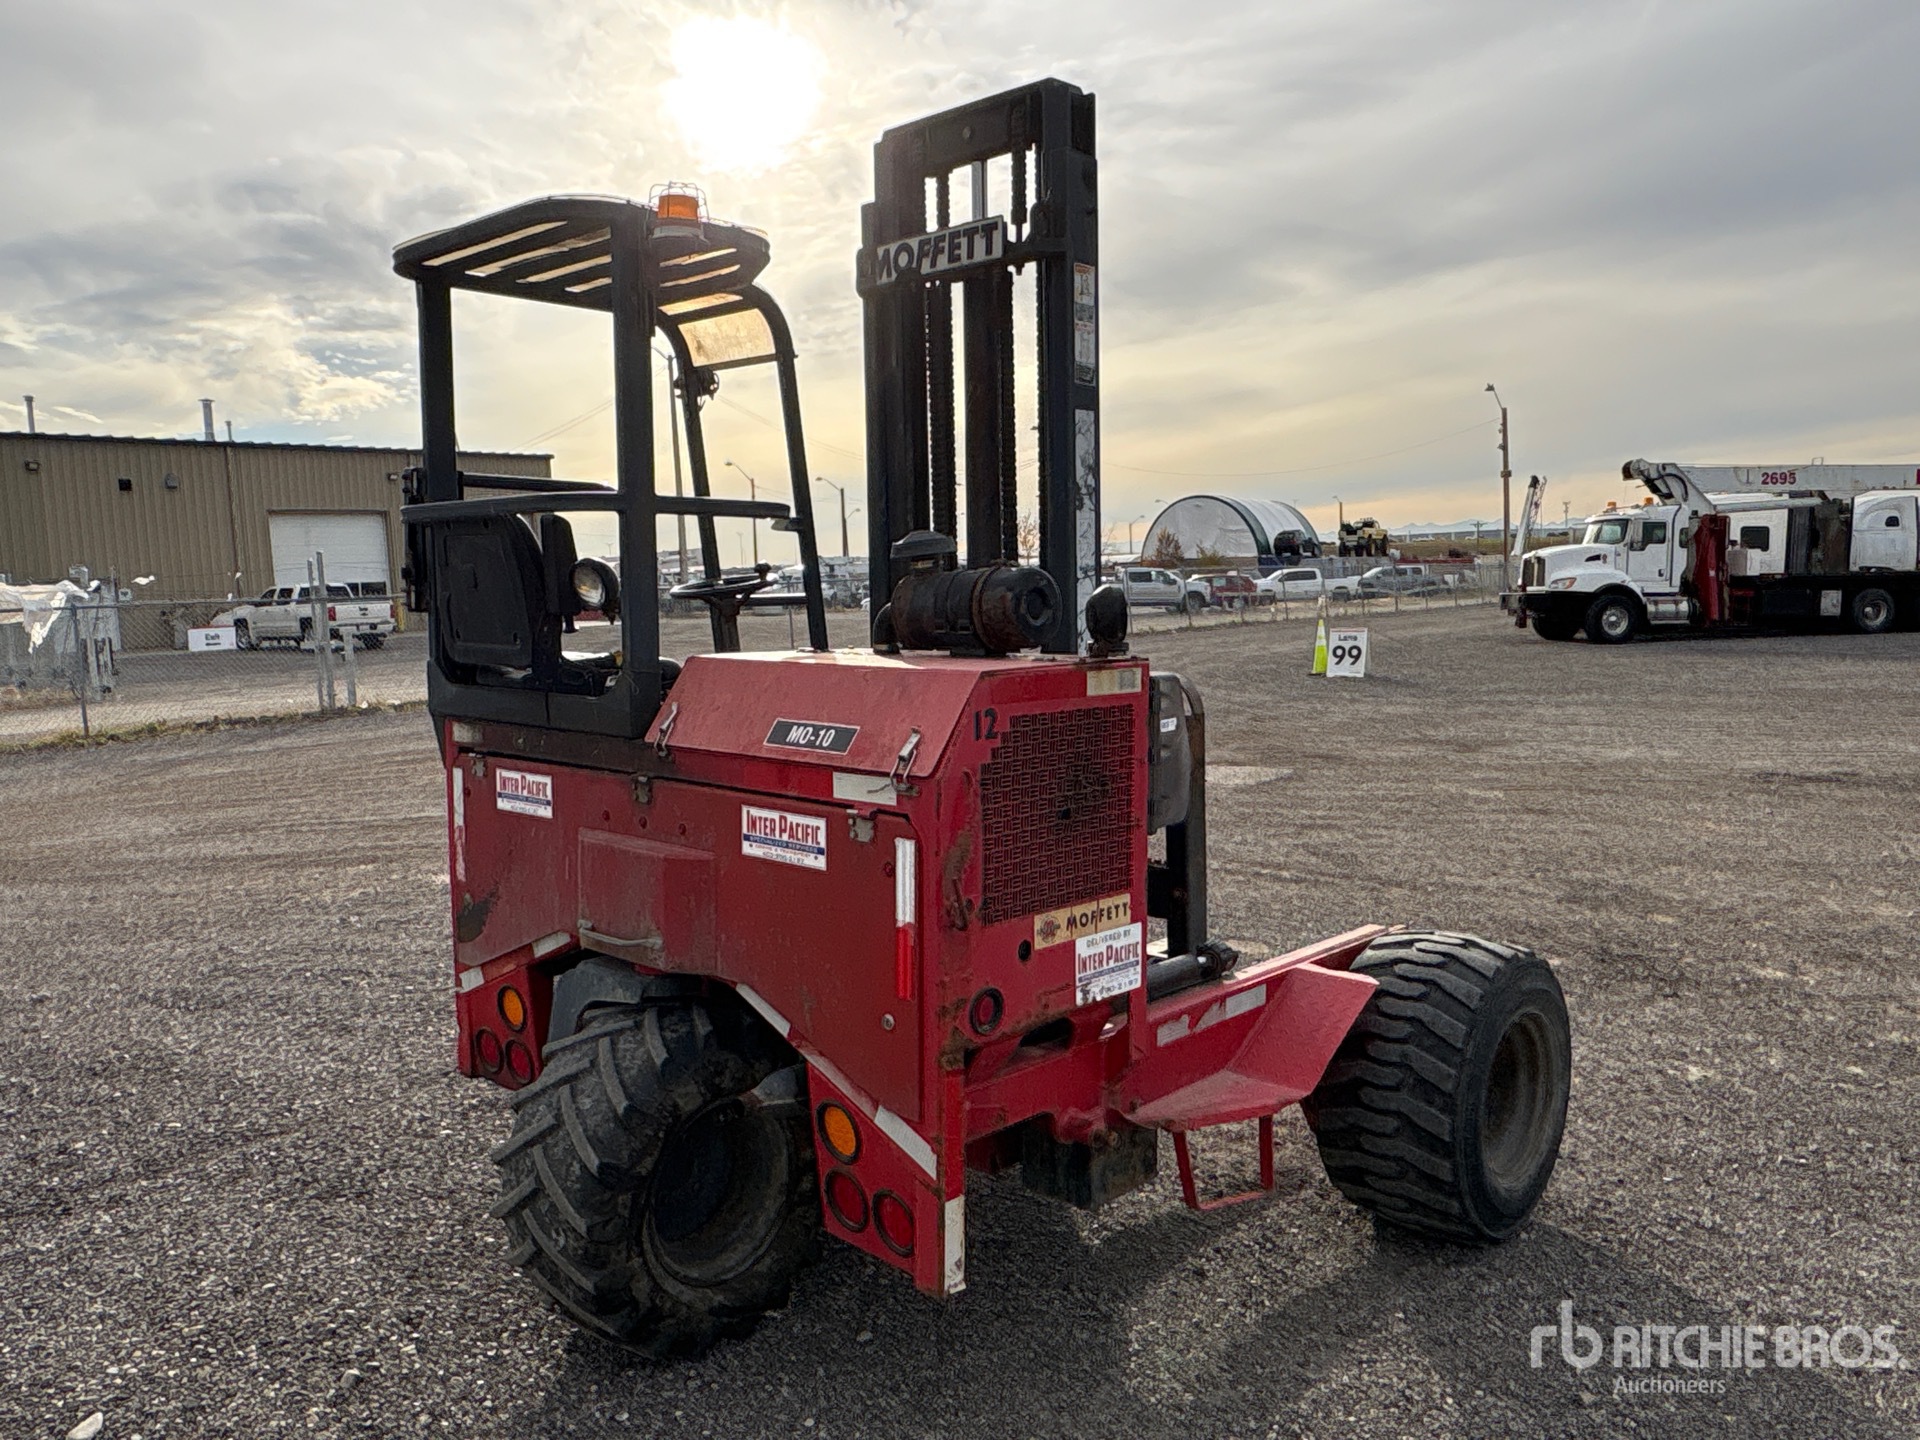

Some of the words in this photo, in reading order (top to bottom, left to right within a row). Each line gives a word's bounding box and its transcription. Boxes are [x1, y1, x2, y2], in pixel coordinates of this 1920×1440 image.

[1761, 471, 1797, 485] 2695
[1332, 645, 1362, 665] 99
[785, 725, 836, 747] MO-10
[974, 708, 1000, 741] 12
[746, 809, 777, 838] INTER
[779, 814, 821, 846] PACIFIC
[1066, 902, 1128, 931] MOFFETT
[1078, 951, 1104, 975] INTER
[1106, 942, 1140, 966] PACIFIC
